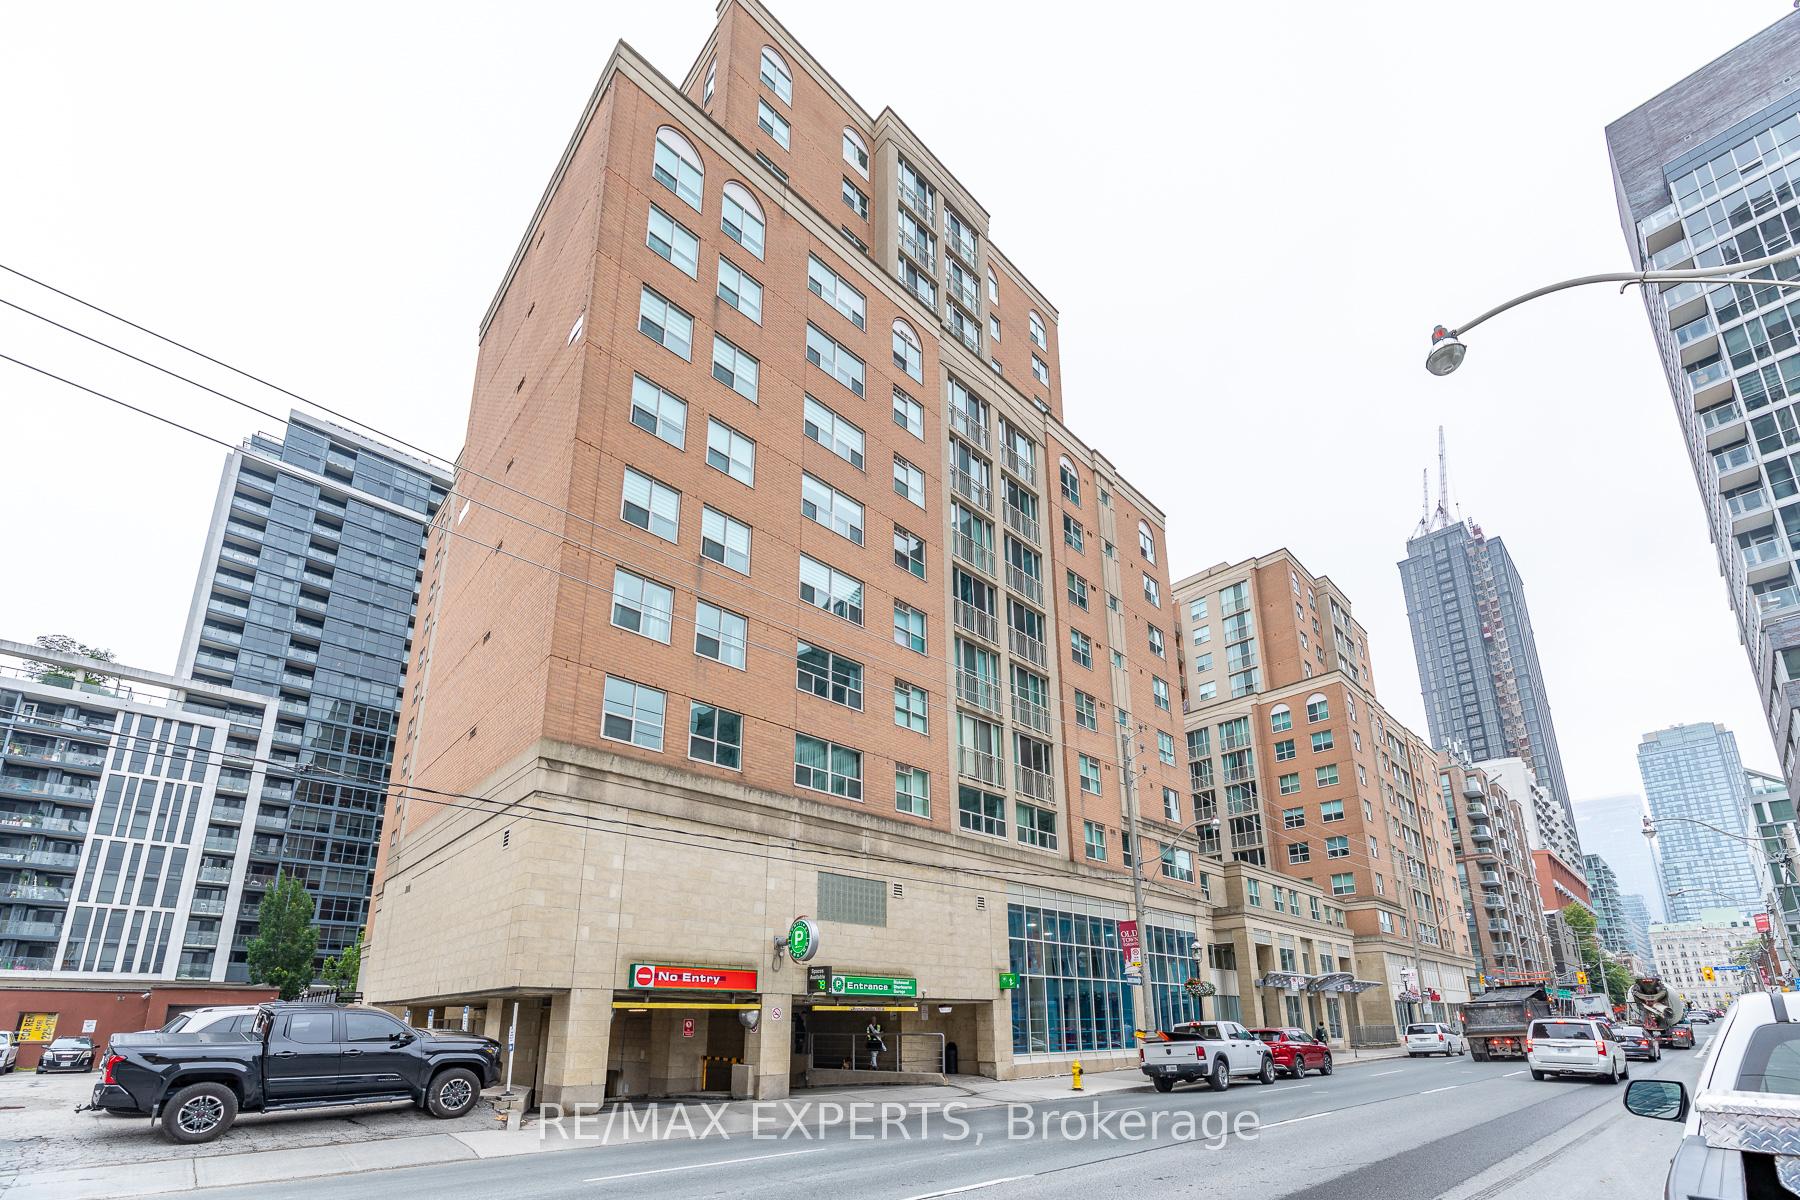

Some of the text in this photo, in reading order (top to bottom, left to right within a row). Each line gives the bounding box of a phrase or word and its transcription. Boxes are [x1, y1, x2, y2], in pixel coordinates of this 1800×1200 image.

[795, 930, 804, 946] P
[658, 971, 721, 985] No Entry
[847, 982, 888, 991] Entrance
[20, 1028, 32, 1040] FOR
